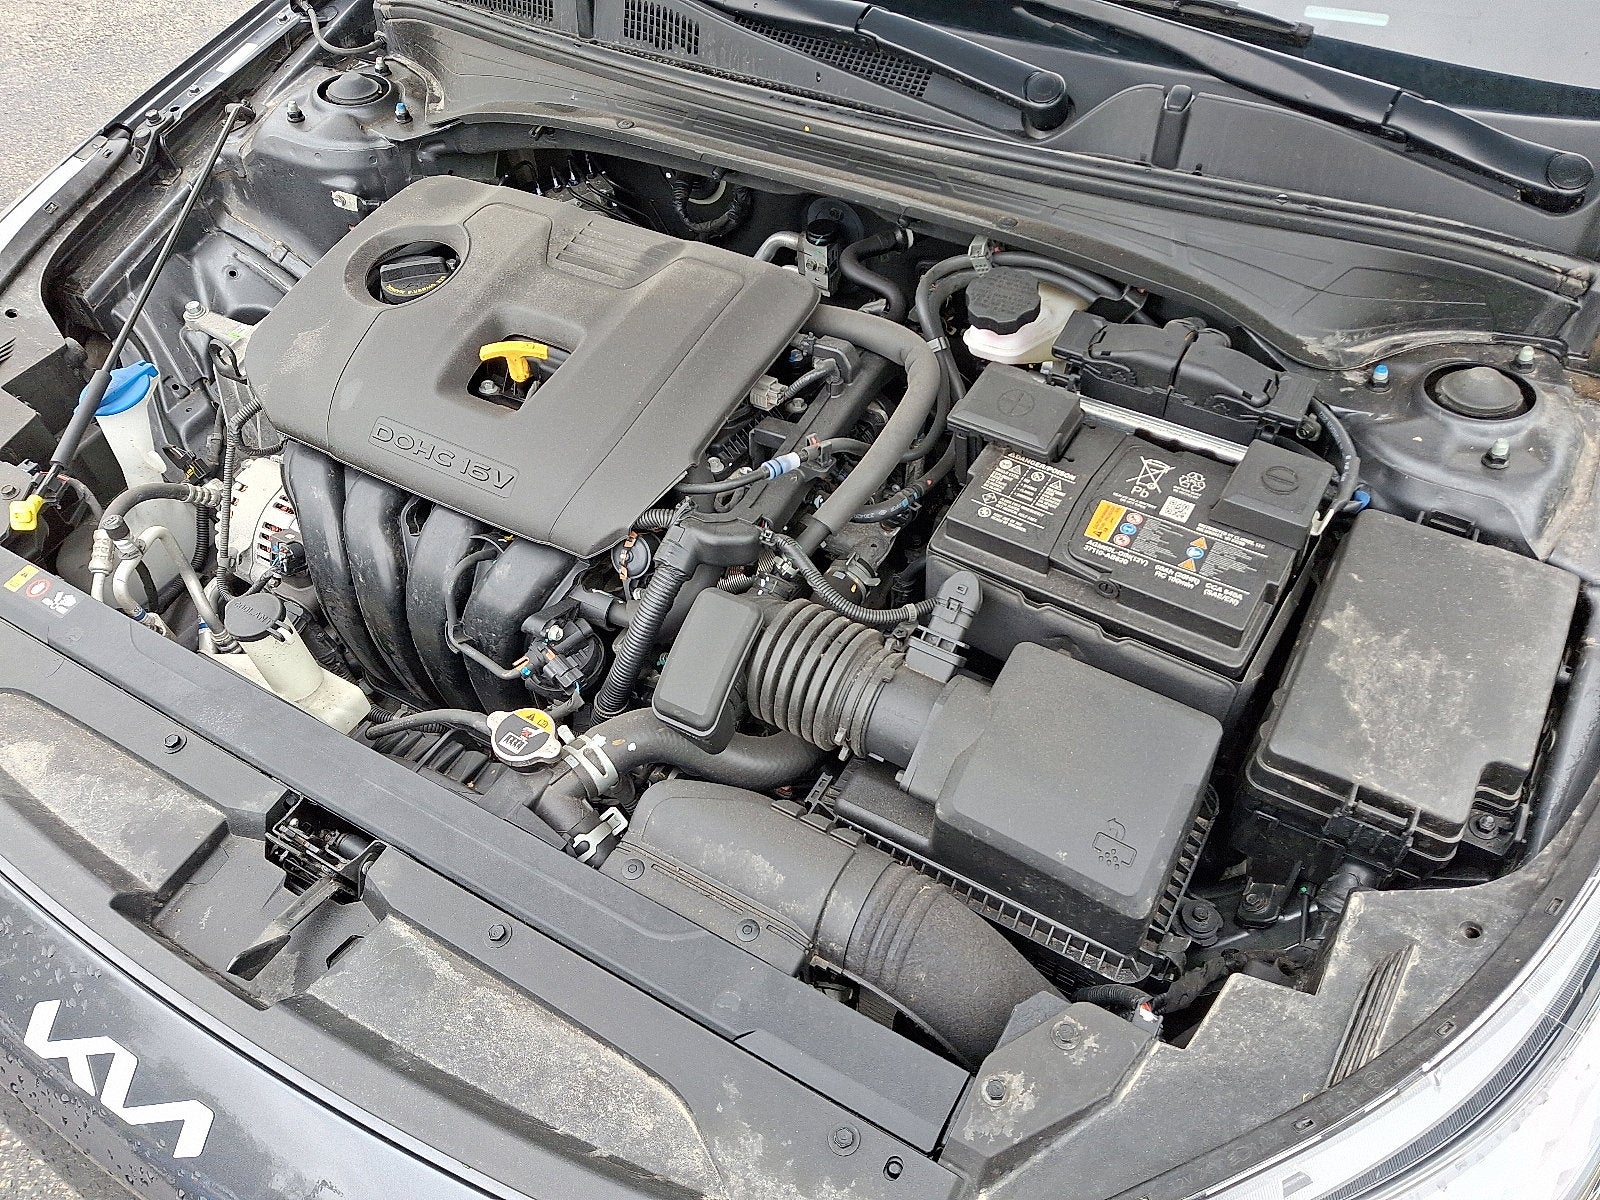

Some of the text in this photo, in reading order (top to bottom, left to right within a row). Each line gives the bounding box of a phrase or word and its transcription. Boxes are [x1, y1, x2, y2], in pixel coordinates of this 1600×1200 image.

[371, 422, 516, 490] DOHC 16V
[1131, 485, 1150, 498] Pb
[1205, 582, 1223, 594] CCA
[23, 999, 216, 1159] KIA
